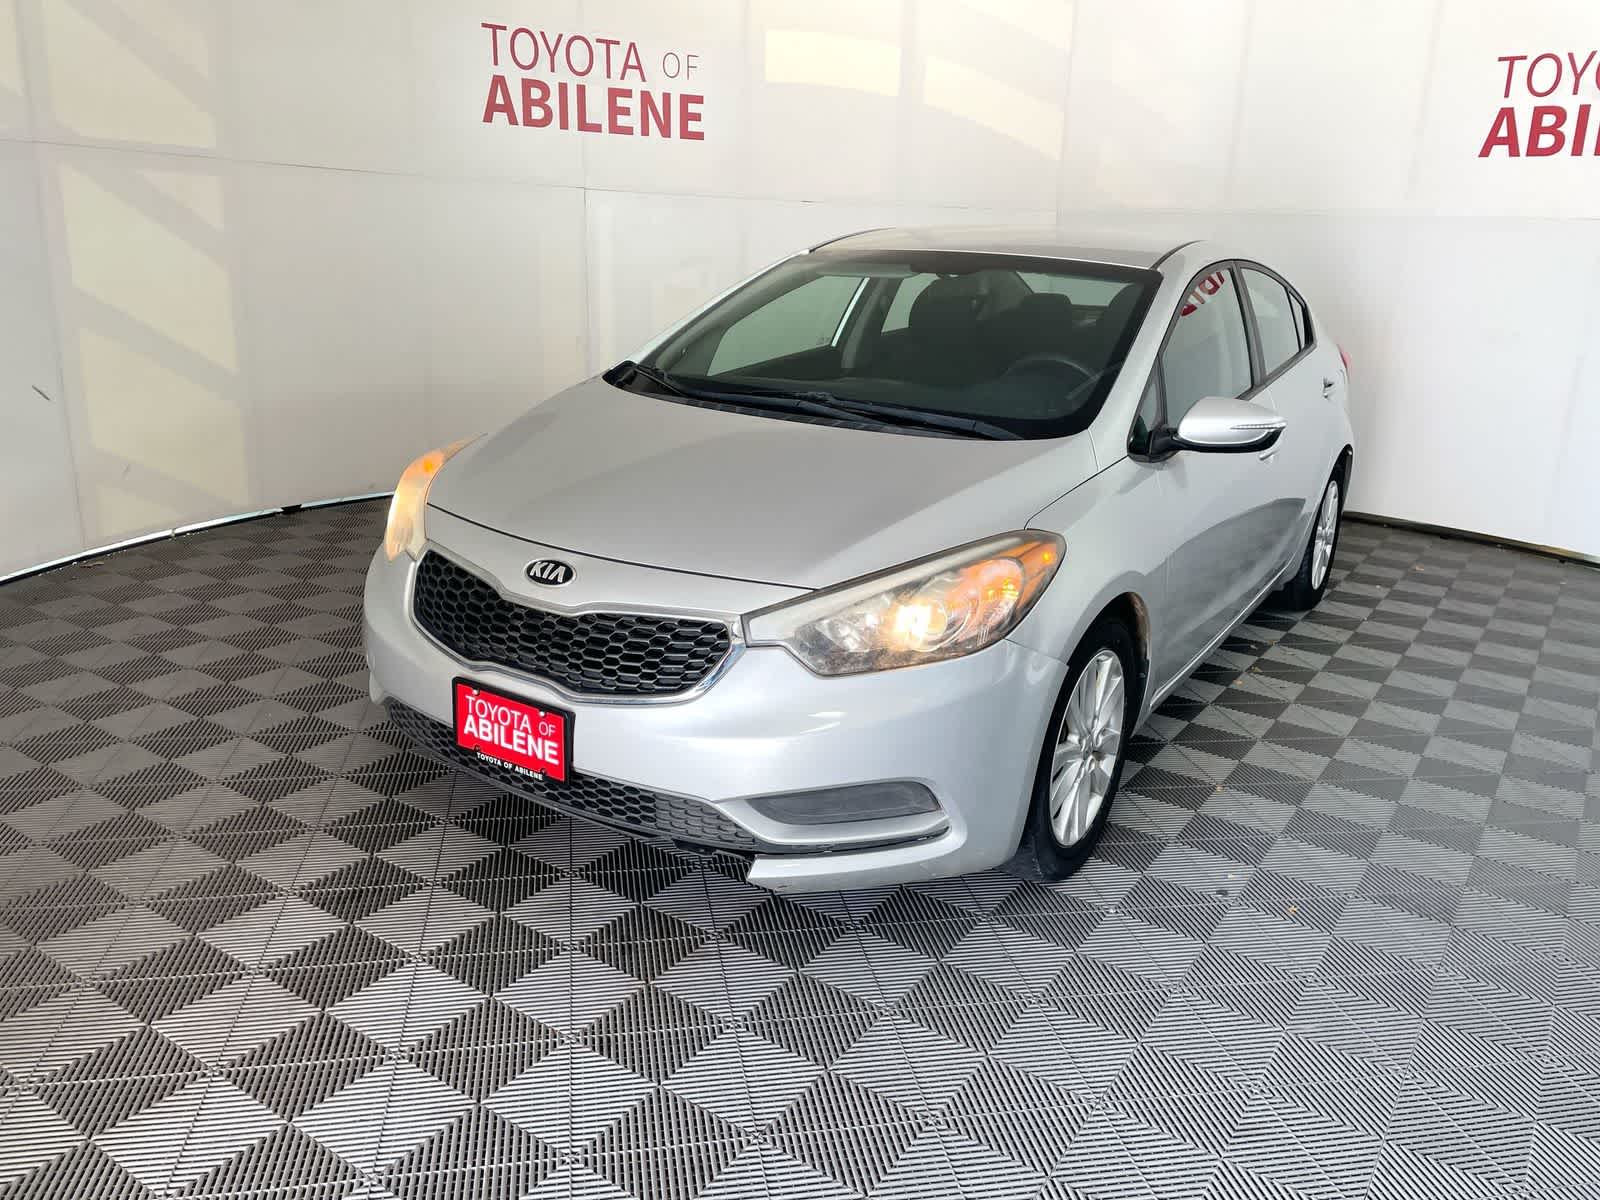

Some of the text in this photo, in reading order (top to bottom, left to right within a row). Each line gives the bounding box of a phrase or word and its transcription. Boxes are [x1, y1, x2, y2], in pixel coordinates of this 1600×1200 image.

[481, 22, 699, 82] TOYOTA OF
[1497, 50, 1600, 98] TOY
[482, 74, 705, 141] ABILENE
[529, 561, 566, 583] KIA
[463, 714, 559, 766] ABILENE
[465, 695, 556, 737] TOYOTA OF
[476, 751, 543, 780] TOYOTA OF ABILENE
